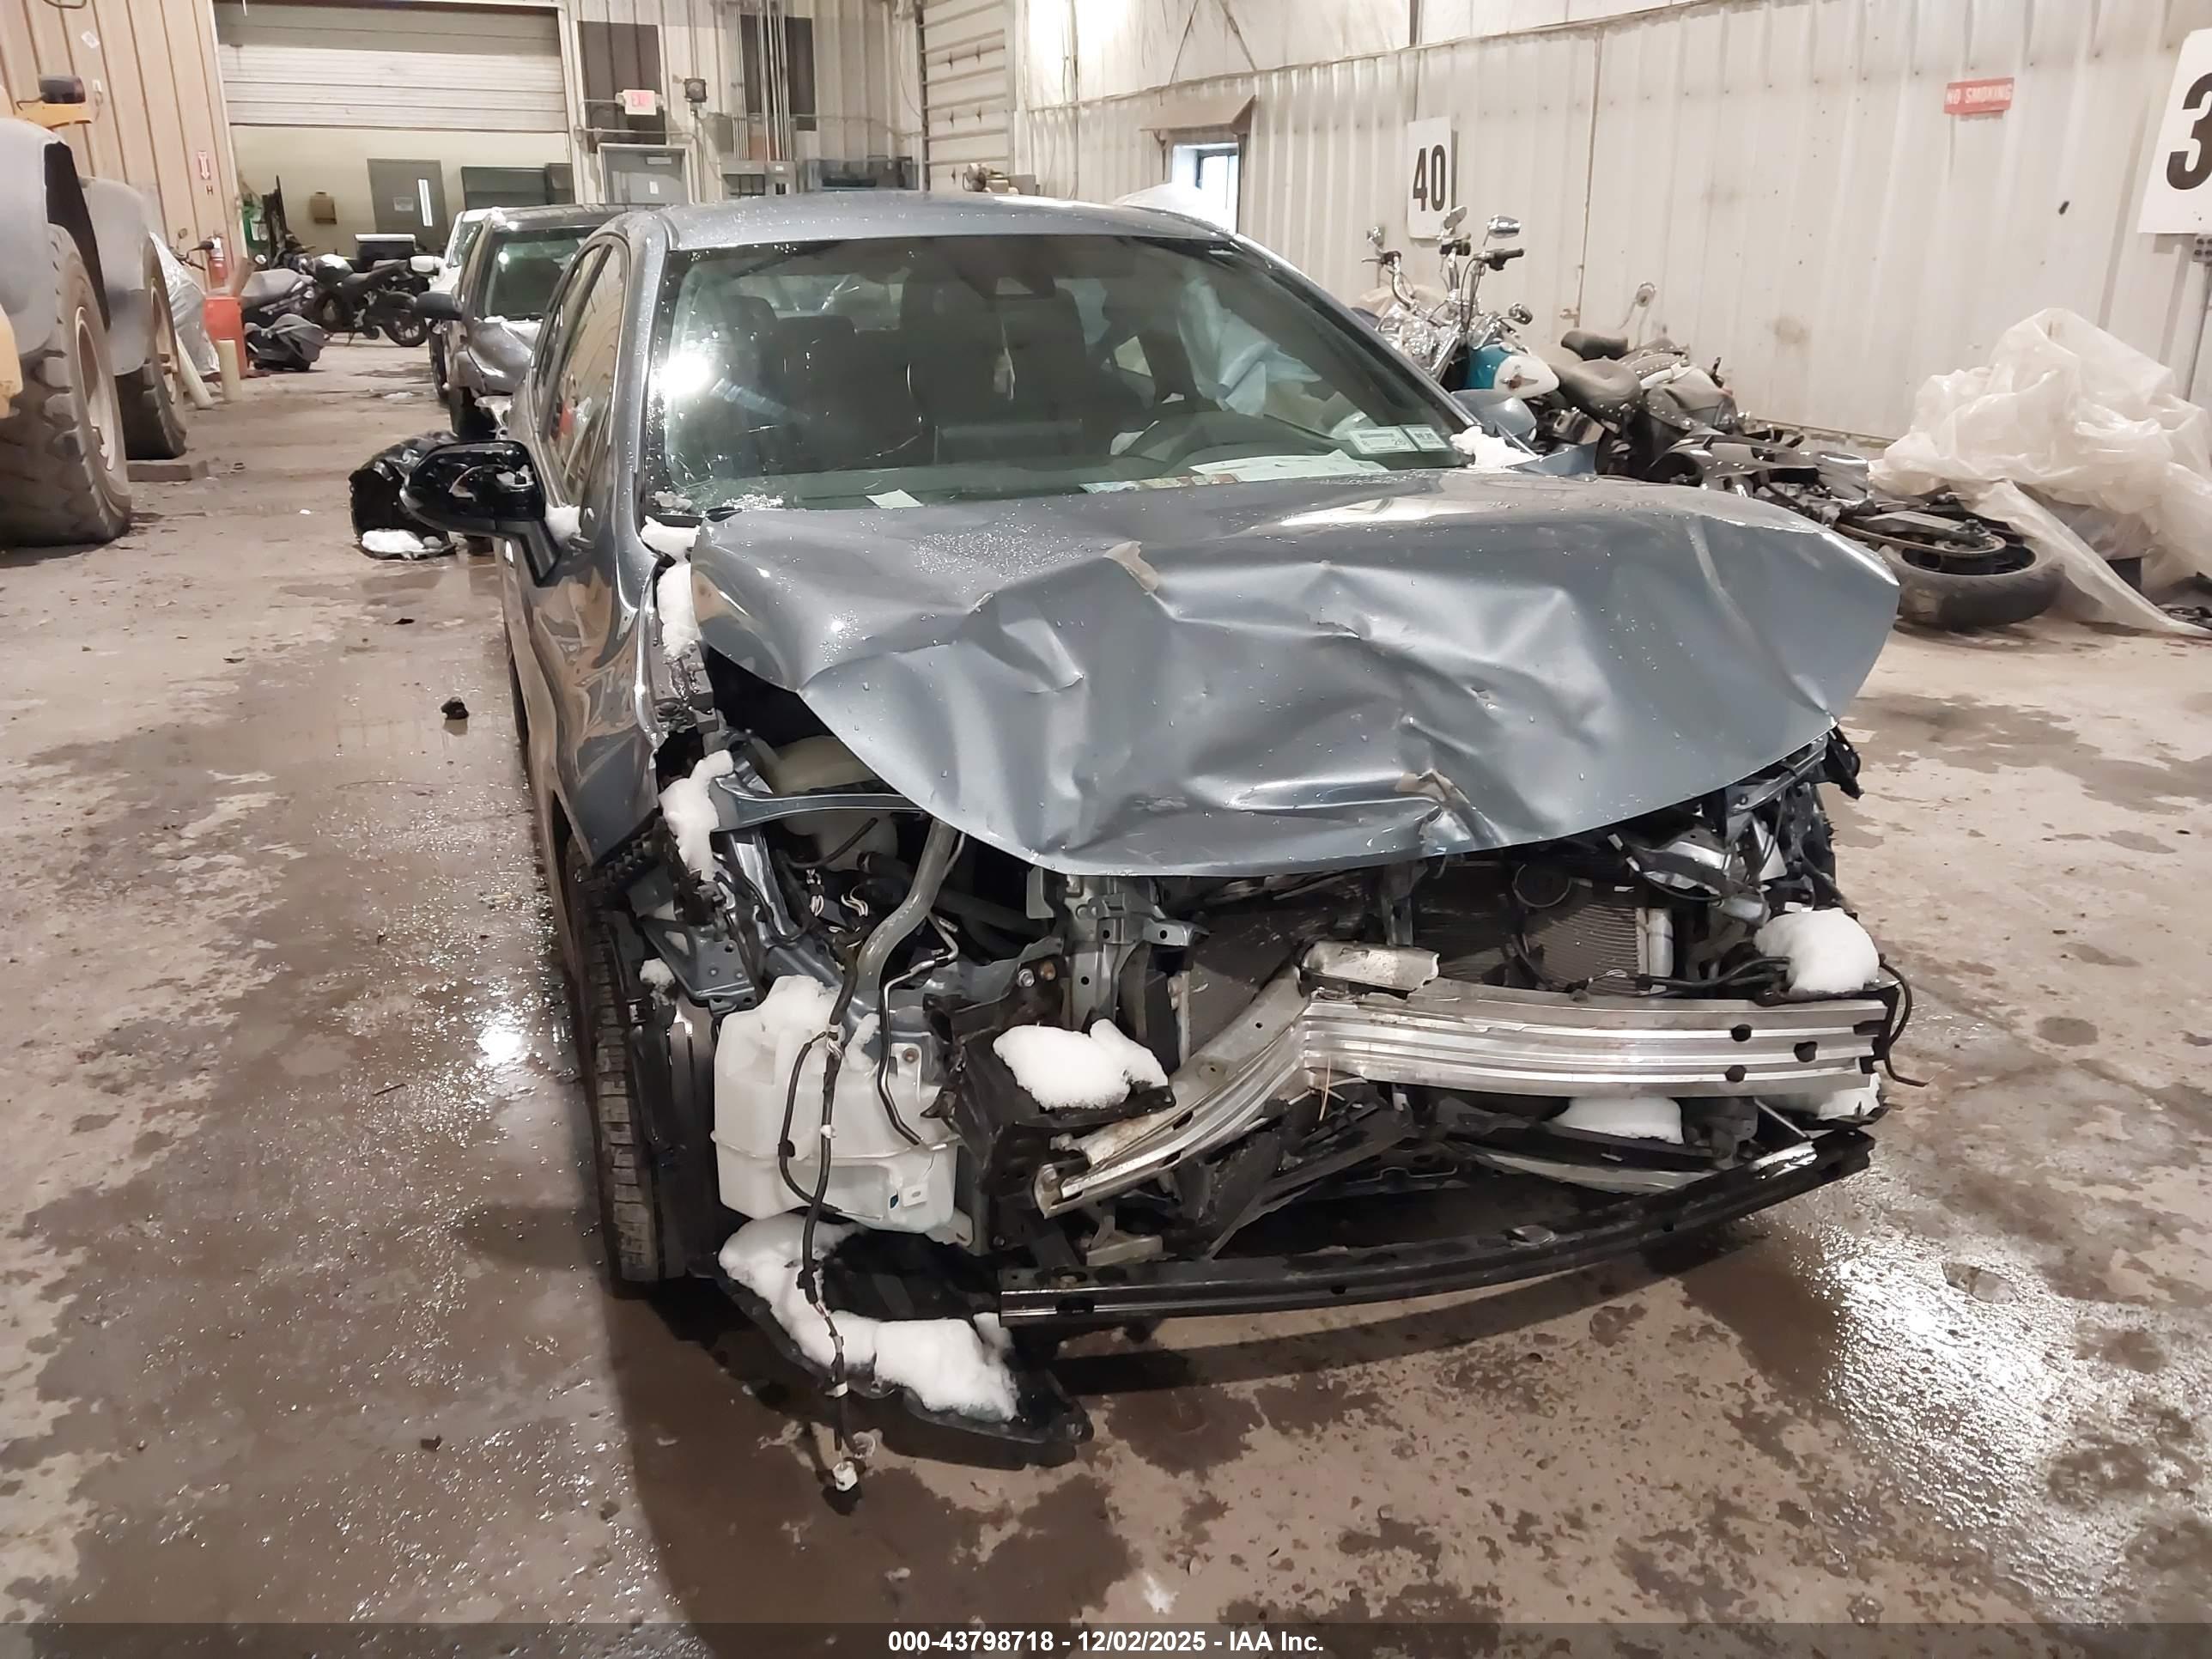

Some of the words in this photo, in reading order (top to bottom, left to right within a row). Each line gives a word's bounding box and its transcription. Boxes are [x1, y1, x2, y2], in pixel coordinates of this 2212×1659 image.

[1946, 88, 1961, 104] NO
[1964, 84, 2012, 103] SMOKING
[1413, 144, 1446, 211] 40
